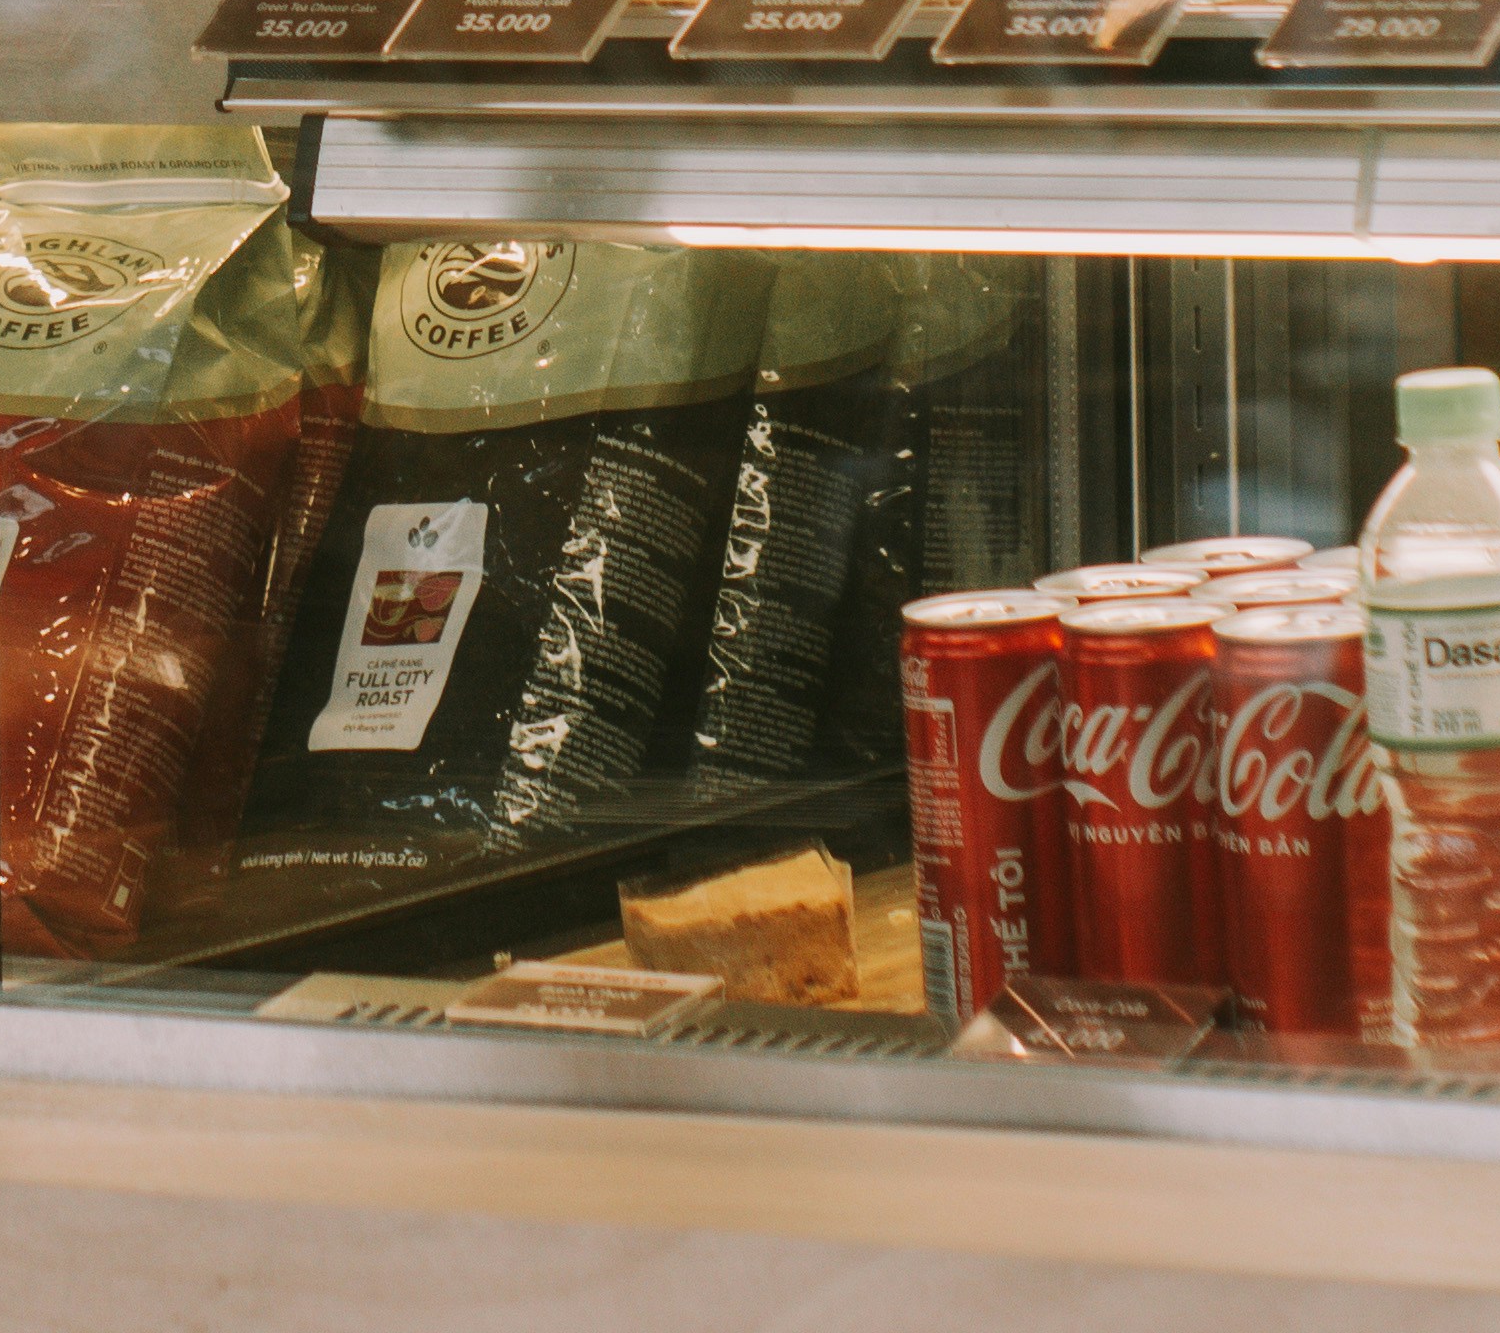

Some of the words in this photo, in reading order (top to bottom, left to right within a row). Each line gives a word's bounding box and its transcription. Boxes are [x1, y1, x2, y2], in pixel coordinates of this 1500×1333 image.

[256, 19, 349, 38] 35.000
[455, 13, 551, 32] 35.000
[743, 11, 843, 31] 35.000
[1335, 17, 1442, 37] 29.000
[121, 160, 156, 170] ROAST
[168, 159, 211, 170] GROUND
[415, 310, 530, 350] COFFEE
[346, 671, 390, 688] FULL
[395, 669, 434, 687] CITY
[355, 689, 415, 707] ROAST
[1083, 821, 1182, 845] NGUYÊN
[1258, 832, 1311, 857] BẢN
[311, 851, 331, 865] Net
[989, 847, 1027, 912] TÔI
